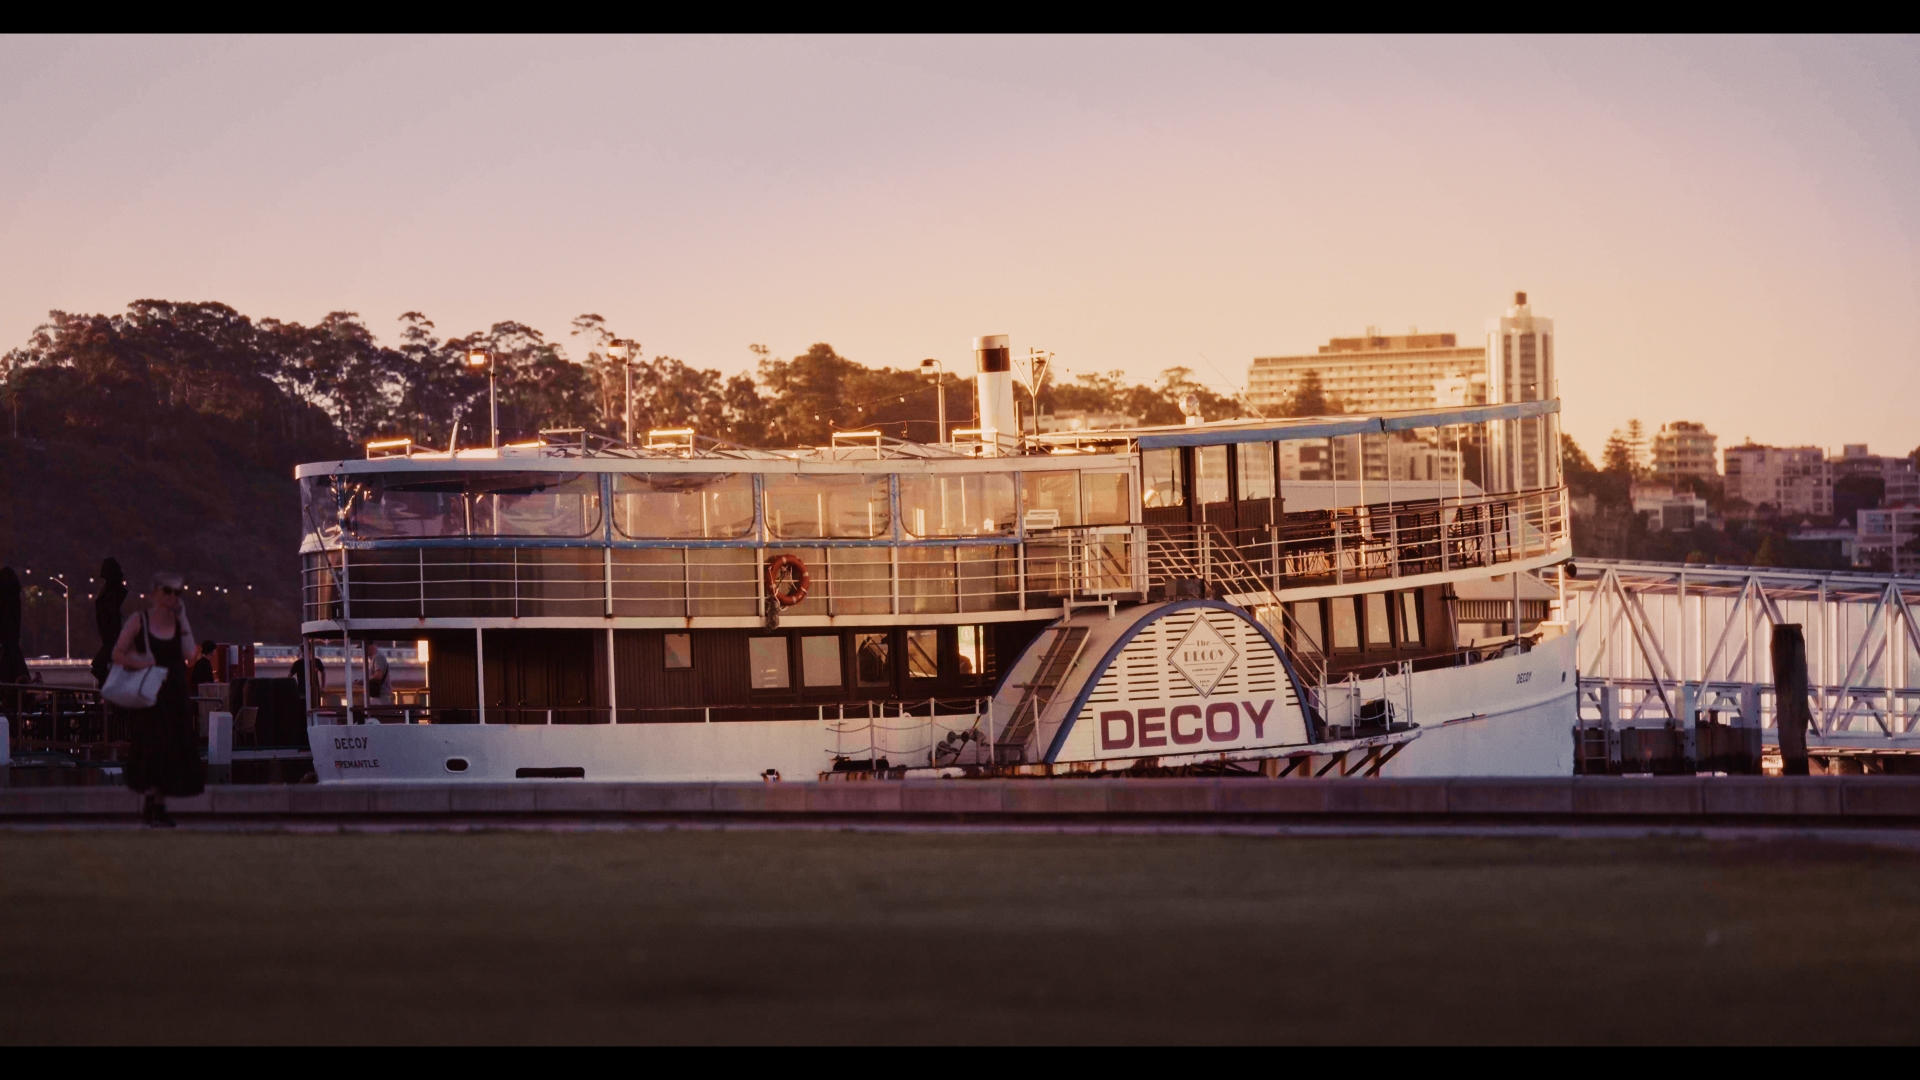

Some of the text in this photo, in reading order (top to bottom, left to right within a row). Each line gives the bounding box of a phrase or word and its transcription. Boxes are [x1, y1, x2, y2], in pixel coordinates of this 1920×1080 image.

[1183, 649, 1226, 662] DECOY
[1100, 700, 1275, 750] DECOY
[334, 736, 368, 750] DECOY
[334, 759, 380, 769] FREMANTLE
